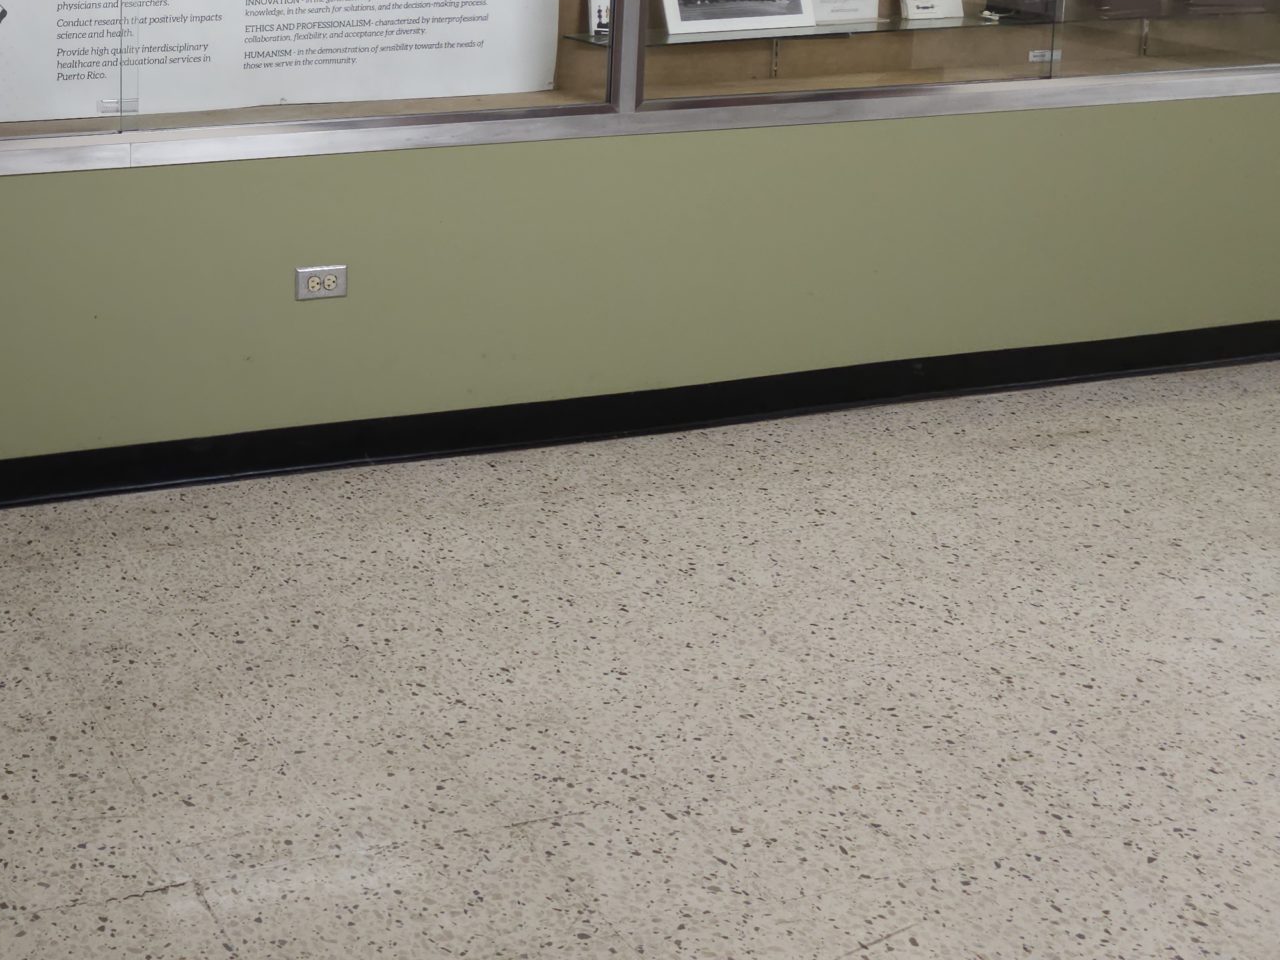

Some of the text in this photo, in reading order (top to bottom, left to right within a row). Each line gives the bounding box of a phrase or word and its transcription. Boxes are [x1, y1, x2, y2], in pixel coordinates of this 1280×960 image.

[57, 0, 169, 12] physicians and researchers.
[57, 14, 222, 28] Conduct research that positively impacts
[57, 29, 134, 40] science and health.
[57, 43, 209, 57] Provide high quality interdisciplinary
[57, 54, 211, 69] healthcare and educational services in
[57, 71, 107, 81] Puerto Rico.
